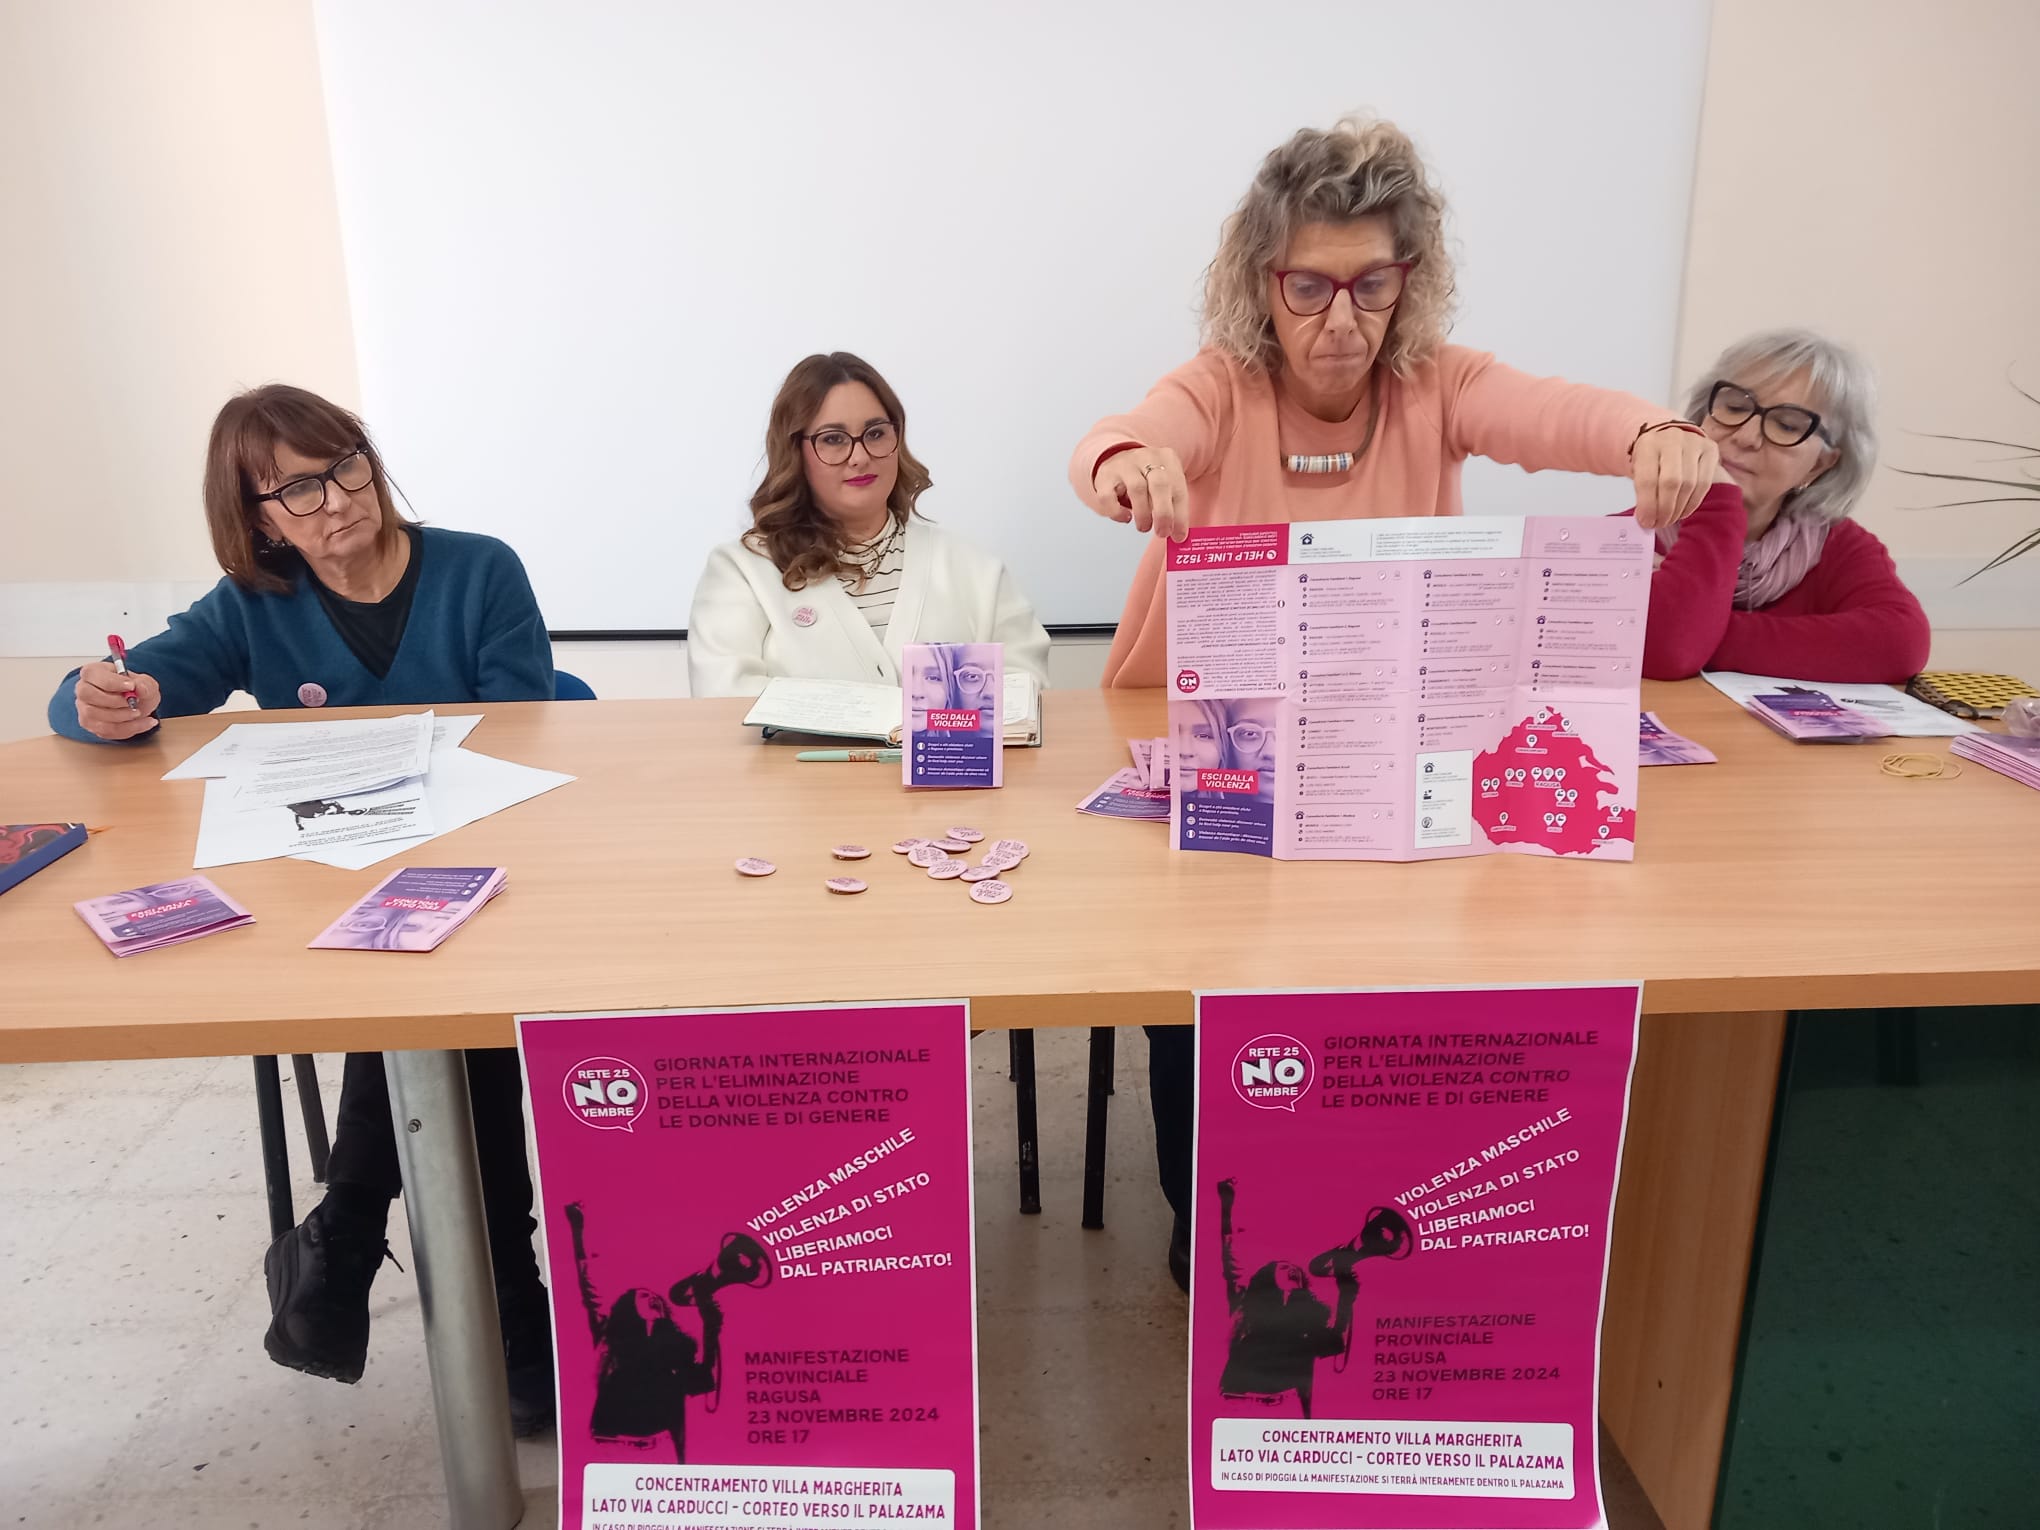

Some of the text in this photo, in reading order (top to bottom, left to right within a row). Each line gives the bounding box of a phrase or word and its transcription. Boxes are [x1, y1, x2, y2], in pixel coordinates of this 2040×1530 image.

[1176, 550, 1264, 564] HELP LINE: 1522
[1180, 677, 1197, 686] NO
[1206, 781, 1250, 790] VIOLENZA
[1224, 774, 1254, 782] DALLA
[1324, 1031, 1598, 1050] GIORNATA INTERNAZIONALE
[654, 1049, 930, 1072] GIORNATA INTERNAZIONALE
[1248, 1046, 1300, 1057] RETE 25
[1324, 1052, 1525, 1070] PER L'ELIMINAZIONE
[578, 1069, 630, 1079] RETE 25
[656, 1070, 859, 1090] PER L'ELIMINAZIONE
[1240, 1059, 1304, 1086] NO
[1323, 1069, 1570, 1089] DELLA VIOLENZA CONTRO
[571, 1079, 638, 1106] NO
[658, 1088, 908, 1110] DELLA VIOLENZA CONTRO
[1247, 1087, 1298, 1097] VEMBRE
[1322, 1088, 1550, 1108] LE DONNE E DI GENERE
[582, 1107, 634, 1117] VEMBRE
[660, 1108, 890, 1128] LE DONNE E DI GENERE
[1394, 1107, 1572, 1208] VIOLENZA MASCHILE
[747, 1128, 916, 1232] VIOLENZA MASCHILE
[1408, 1150, 1580, 1220] VIOLENZA DI STATO
[762, 1172, 930, 1246] VIOLENZA DI STATO
[1418, 1200, 1535, 1236] LIBERIAMOCI
[775, 1226, 892, 1262] LIBERIAMOCI
[1420, 1224, 1589, 1251] DAL PATRIARCATO!
[780, 1252, 952, 1278] DAL PATRIARCATO!
[1376, 1314, 1536, 1330] MANIFESTAZIONE
[1375, 1332, 1493, 1348] PROVINCIALE
[745, 1348, 910, 1365] MANIFESTAZIONE
[1374, 1351, 1446, 1365] RAGUSA
[746, 1369, 868, 1384] PROVINCIALE
[1374, 1367, 1560, 1384] 23 NOVEMBRE 2024
[747, 1390, 821, 1404] RAGUSA
[1372, 1386, 1432, 1400] ORE 17
[748, 1408, 938, 1424] 23 NOVEMBRE 2024
[747, 1429, 810, 1444] ORE 17
[1262, 1430, 1522, 1448] CONCENTRAMENTO VILLA MARGHERITA
[1220, 1449, 1254, 1462] LATO
[1258, 1450, 1279, 1463] VIA
[1284, 1450, 1352, 1464] CARDUCCI
[1366, 1452, 1421, 1466] CORTEO
[1426, 1453, 1470, 1466] VERSO
[1476, 1454, 1486, 1467] IL
[1490, 1455, 1564, 1469] PALAZAMA
[636, 1477, 902, 1496] CONCENTRAMENTO VILLA MARGHERITA
[1222, 1472, 1564, 1488] IN CASO DI PIOGGIA LA MANIFESTAZIONE SI TERRÀ INTERAMENTE DENTRO IL PALAZAMA
[592, 1498, 626, 1512] LATO
[632, 1499, 652, 1514] VIA
[657, 1500, 728, 1514] CARDUCCI
[742, 1502, 798, 1516] CORTEO
[803, 1502, 849, 1518] VERSO
[854, 1504, 864, 1518] IL
[869, 1504, 945, 1519] PALAZAMA
